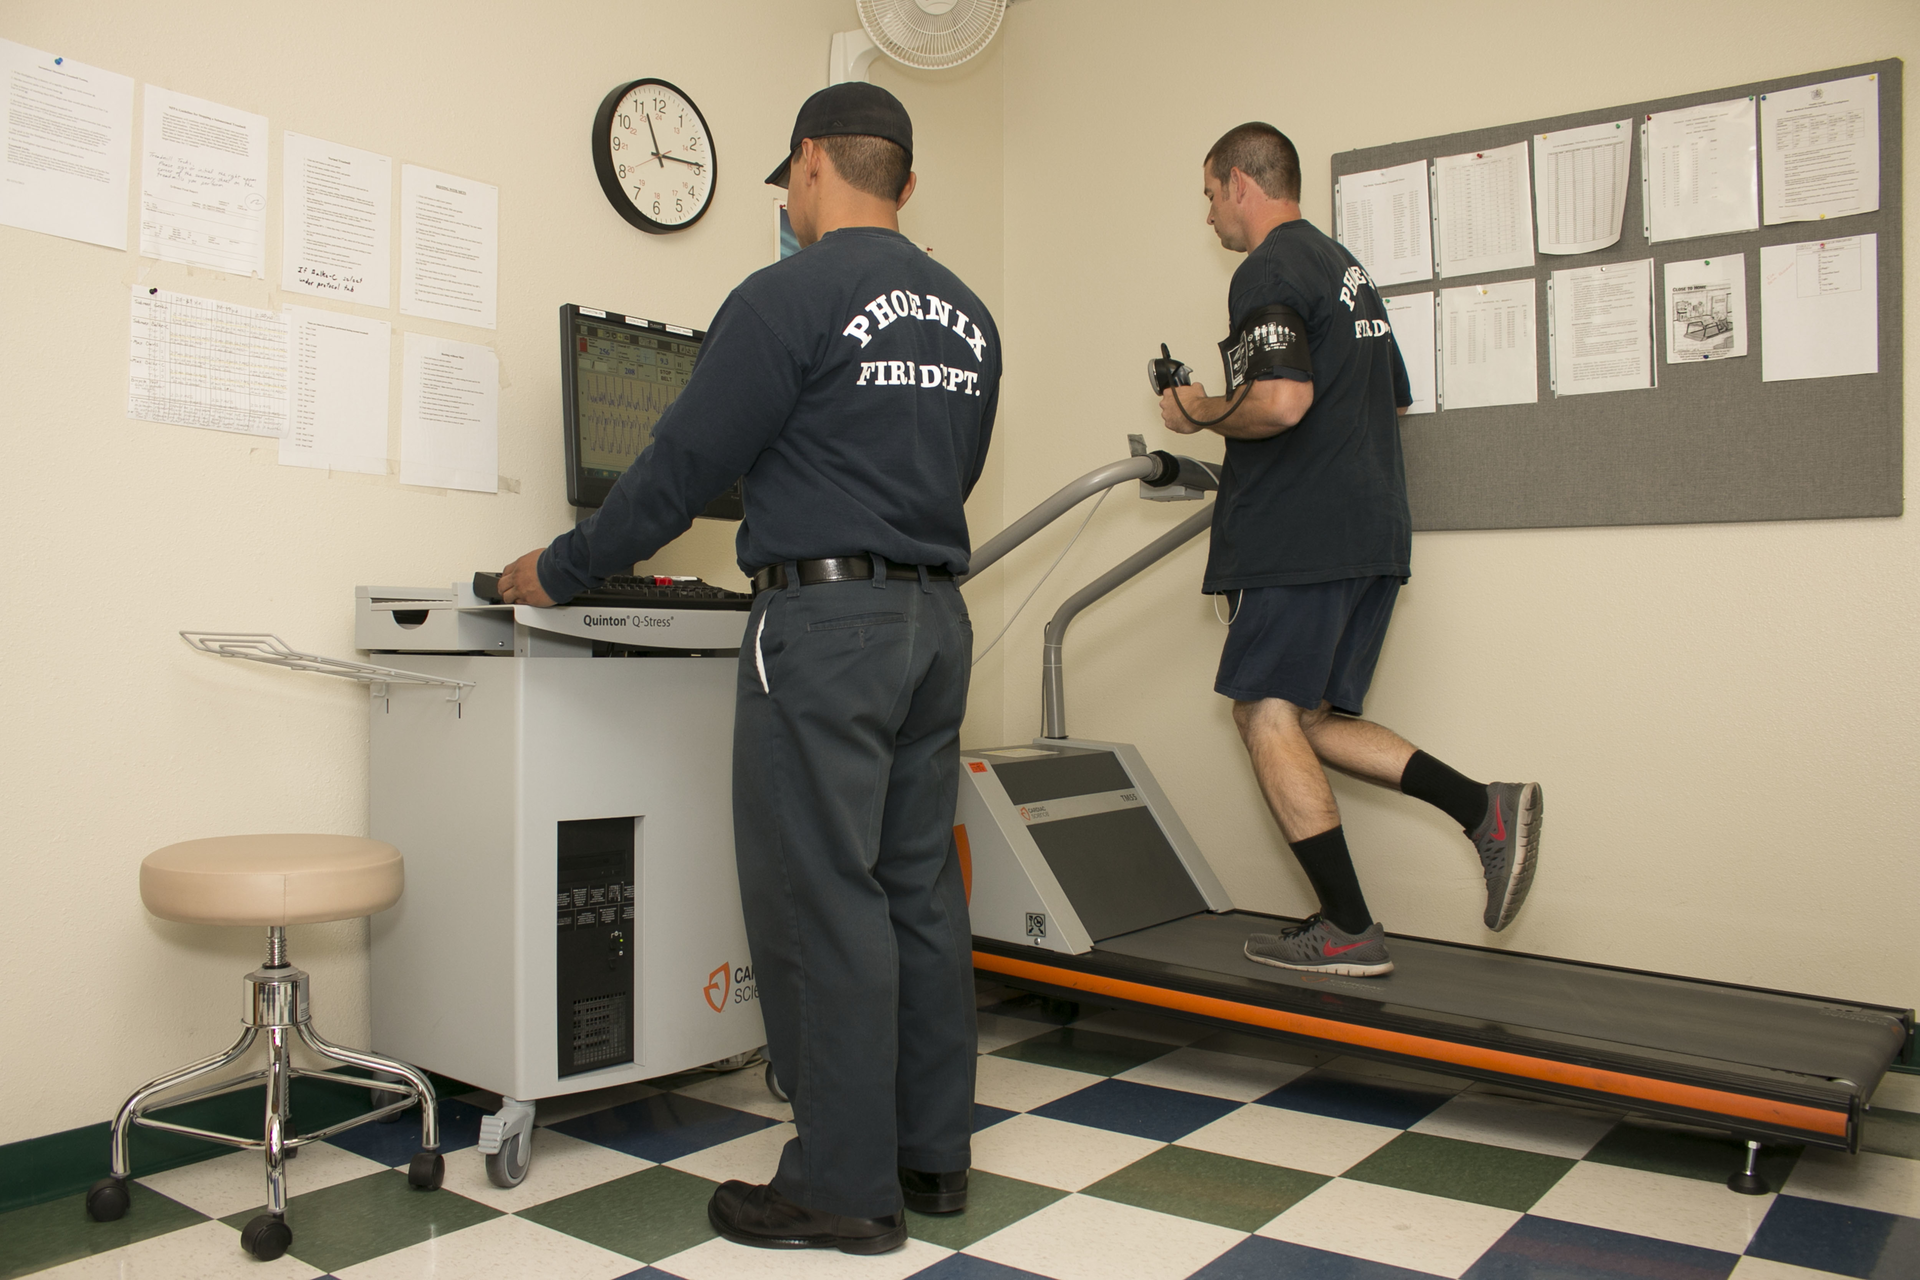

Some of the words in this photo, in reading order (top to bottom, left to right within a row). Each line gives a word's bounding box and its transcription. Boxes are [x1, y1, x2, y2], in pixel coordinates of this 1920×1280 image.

[633, 99, 645, 115] 11
[653, 97, 667, 115] 12
[617, 113, 631, 130] 10
[640, 115, 647, 123] 23
[655, 113, 662, 121] 24
[678, 114, 683, 128] 1
[629, 127, 638, 135] 22
[674, 127, 680, 135] 13
[612, 136, 621, 151] 9
[621, 143, 629, 151] 21
[689, 137, 697, 152] 2
[618, 164, 627, 179] 8
[627, 166, 635, 174] 20
[693, 162, 701, 176] 3
[639, 179, 646, 187] 19
[633, 185, 641, 201] 7
[654, 192, 661, 200] 18
[688, 185, 695, 199] 4
[652, 200, 661, 215] 6
[675, 198, 683, 213] 5
[299, 278, 314, 286] under
[316, 282, 341, 290] protocol
[344, 284, 354, 293] tab
[842, 289, 986, 363] PHOENIX
